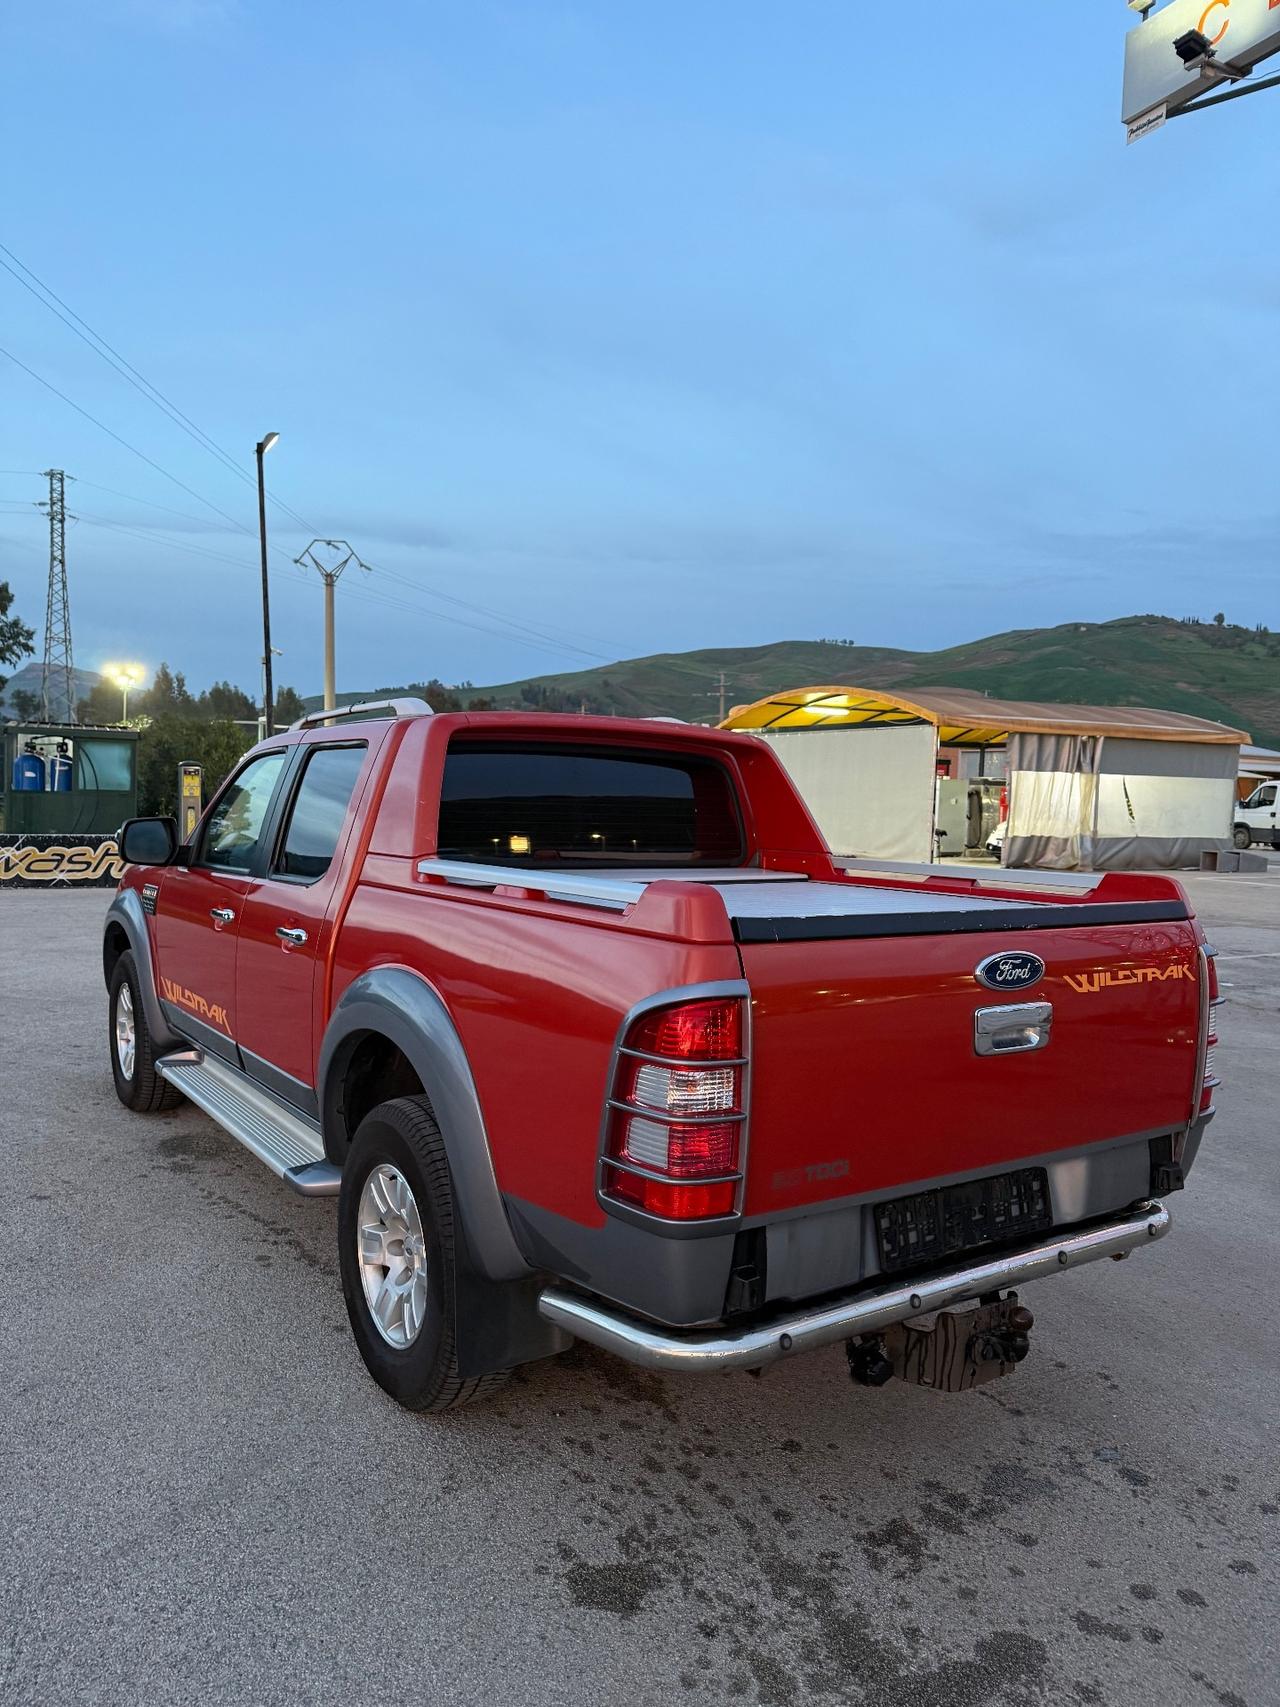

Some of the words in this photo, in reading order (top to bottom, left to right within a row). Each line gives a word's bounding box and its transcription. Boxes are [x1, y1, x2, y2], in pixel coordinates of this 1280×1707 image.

[996, 959, 1031, 980] Ford
[1063, 965, 1196, 993] WILDTRAK
[161, 976, 232, 1035] WILDTRAK
